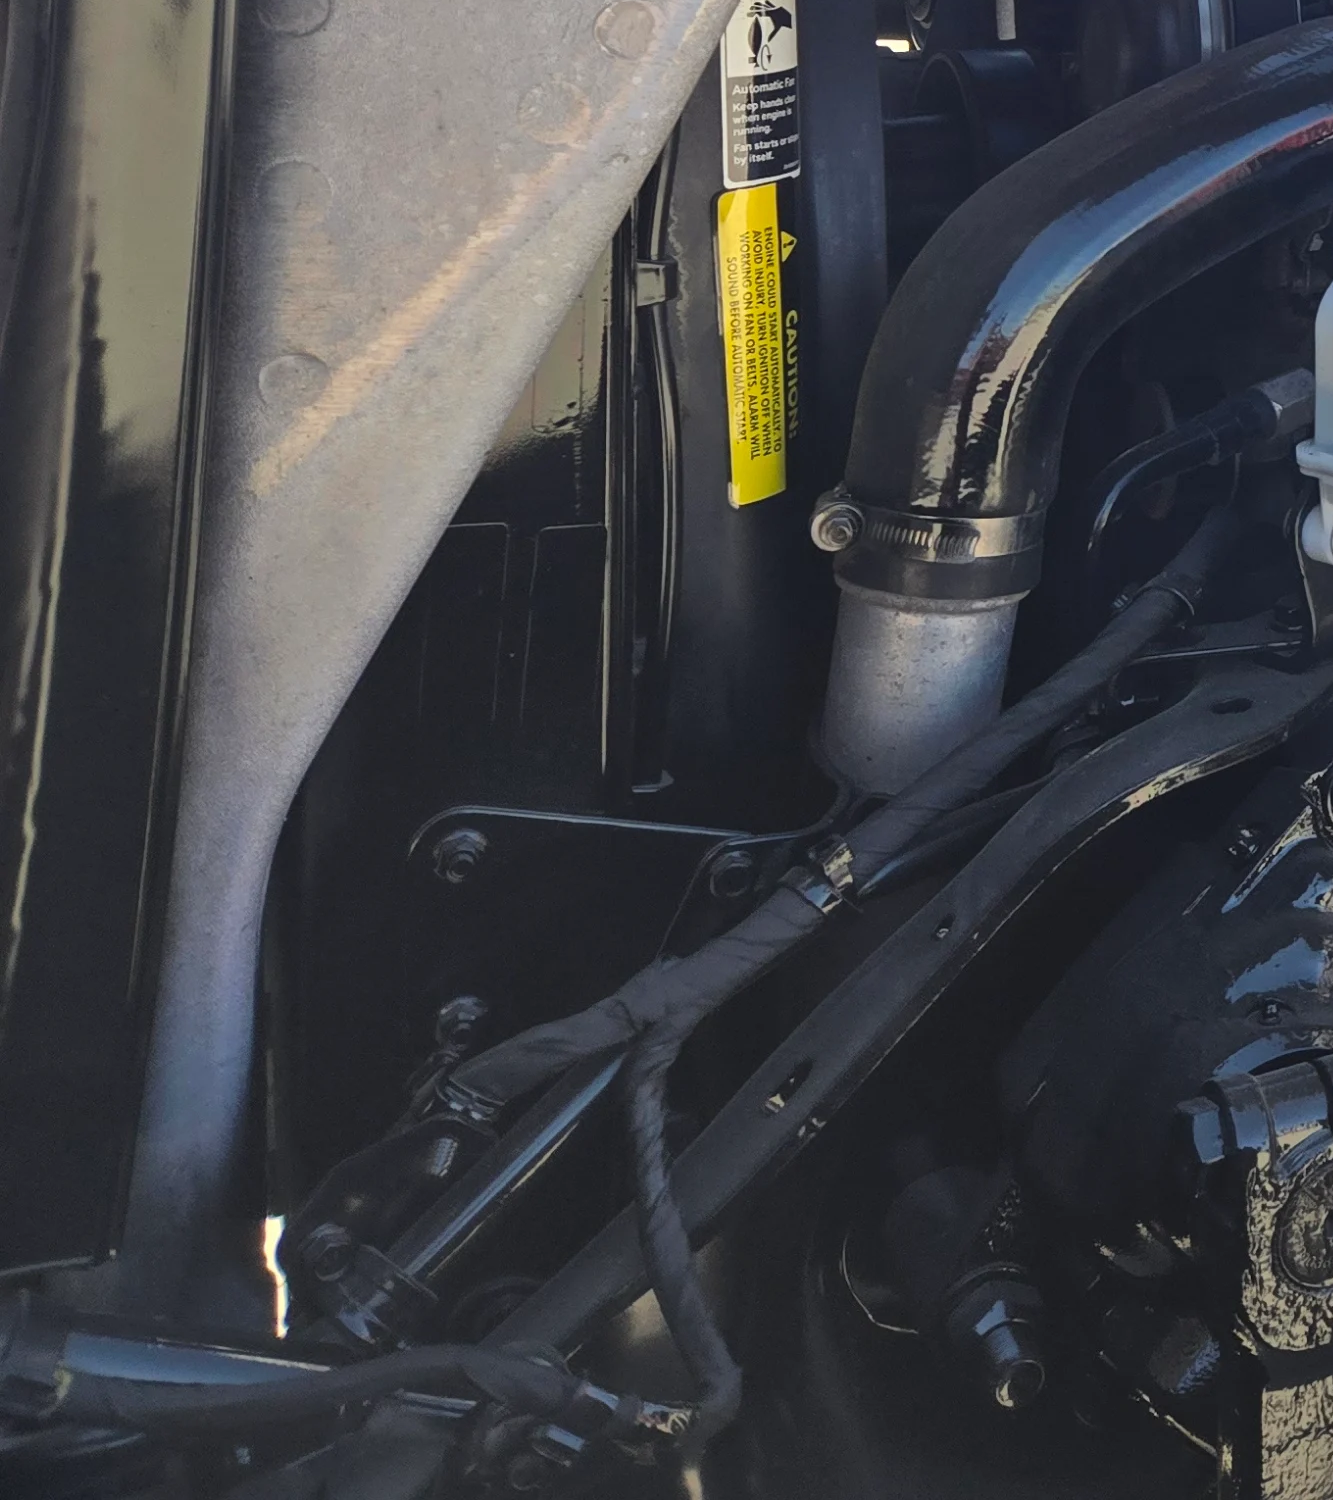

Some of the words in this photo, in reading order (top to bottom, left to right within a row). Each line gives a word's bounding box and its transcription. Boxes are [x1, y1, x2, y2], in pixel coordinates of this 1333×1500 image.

[732, 80, 784, 96] Automatic
[732, 102, 759, 113] Keep
[760, 97, 784, 109] hands
[732, 113, 760, 125] when
[761, 109, 786, 121] engine
[733, 124, 773, 137] running.
[733, 143, 753, 153] Fan
[754, 139, 779, 151] starts
[733, 155, 748, 167] by
[749, 150, 775, 164] itself.
[739, 231, 752, 289] WORKING
[752, 230, 763, 265] AVOID
[764, 226, 775, 270] ENGINE
[726, 256, 739, 298] SOUND
[754, 267, 766, 310] INJURY,
[766, 271, 777, 309] COULD
[743, 291, 754, 311] ON
[729, 300, 742, 341] BEFORE
[744, 313, 755, 336] FAN
[756, 311, 767, 341] TURN
[768, 311, 779, 342] START
[745, 338, 755, 356] OR
[731, 344, 746, 409] AUTOMATIC
[746, 358, 758, 391] BELTS.
[758, 343, 770, 396] IGNITION
[785, 309, 799, 440] CAUTION:
[769, 346, 781, 435] AUTOMATICALLY.
[748, 394, 759, 433] ALARM
[760, 397, 770, 419] OFF
[735, 410, 747, 445] START.
[762, 422, 772, 457] WHEN
[750, 434, 761, 461] WILL
[773, 436, 782, 453] TO
